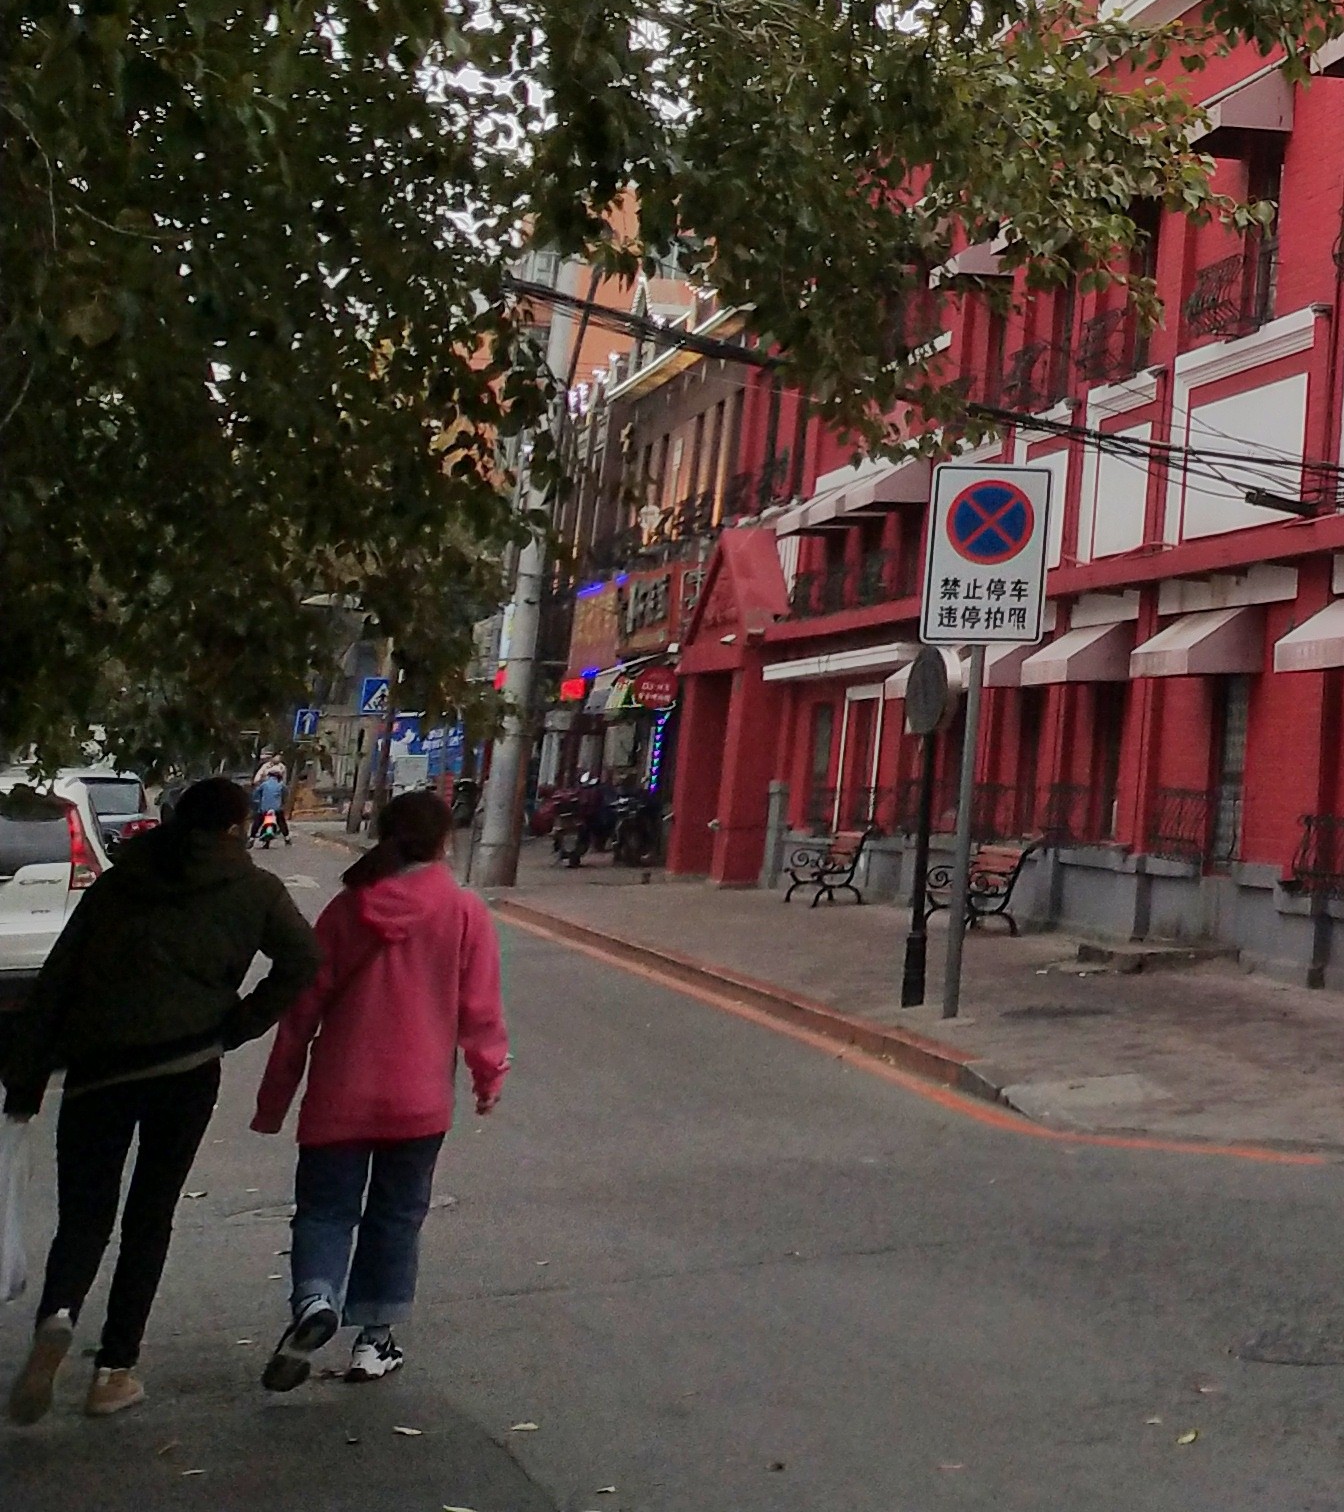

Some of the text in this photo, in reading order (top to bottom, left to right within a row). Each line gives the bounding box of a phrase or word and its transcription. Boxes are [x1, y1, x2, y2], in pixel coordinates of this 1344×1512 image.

[940, 577, 1029, 602] 禁止停车
[938, 605, 1027, 630] 违停拍照
